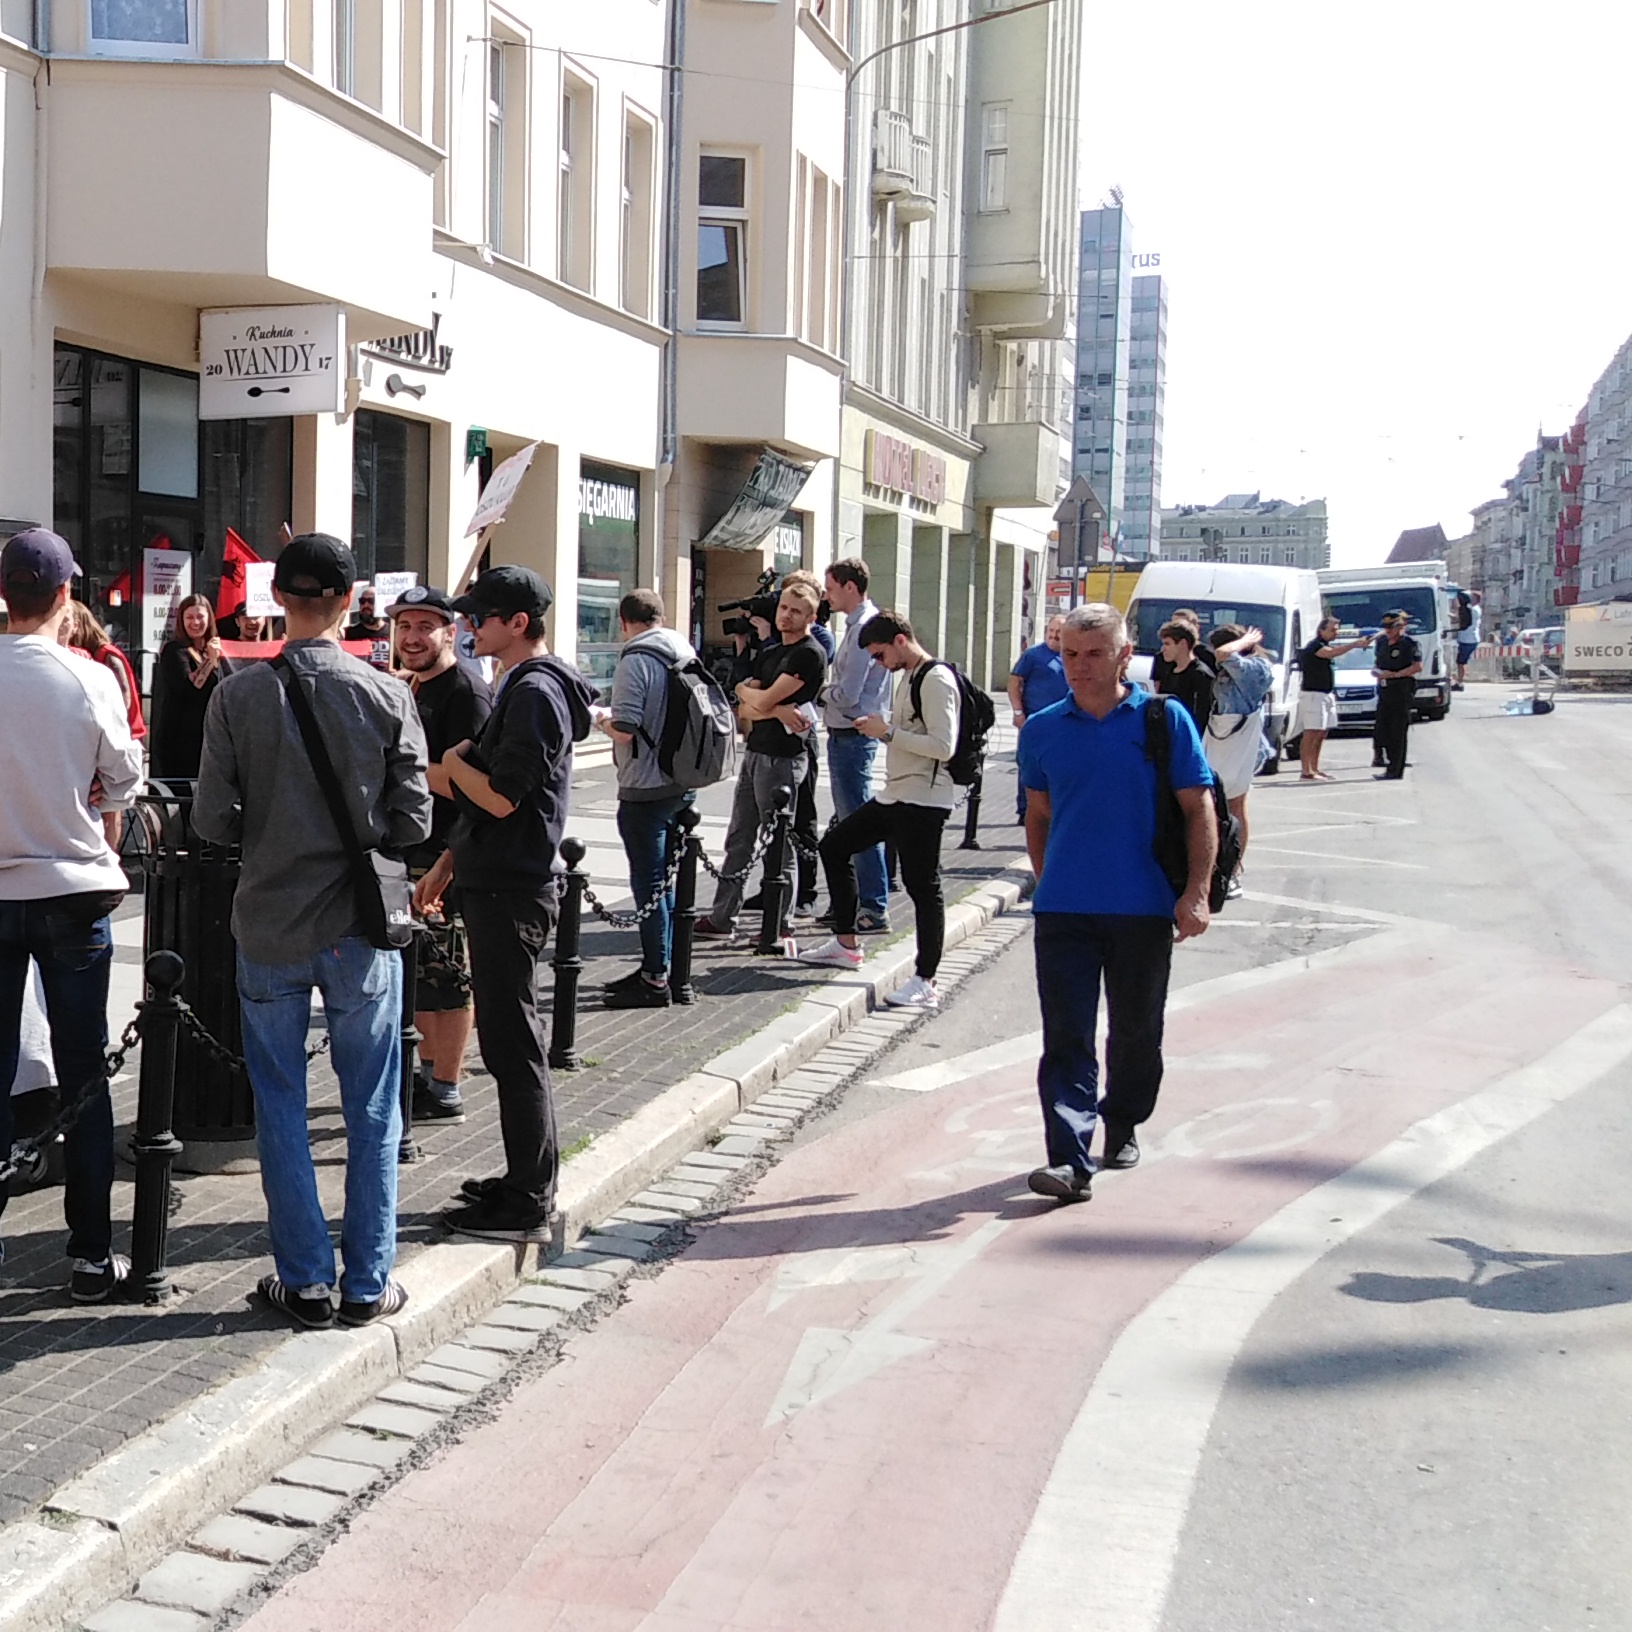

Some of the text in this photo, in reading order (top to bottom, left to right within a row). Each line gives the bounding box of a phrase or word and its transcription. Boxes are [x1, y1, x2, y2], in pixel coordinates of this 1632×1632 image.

[246, 324, 294, 342] Kuchnia
[206, 343, 333, 376] 20 WANDY 17
[578, 477, 636, 525] SIĘGARNIA
[1574, 645, 1624, 658] SWECO
